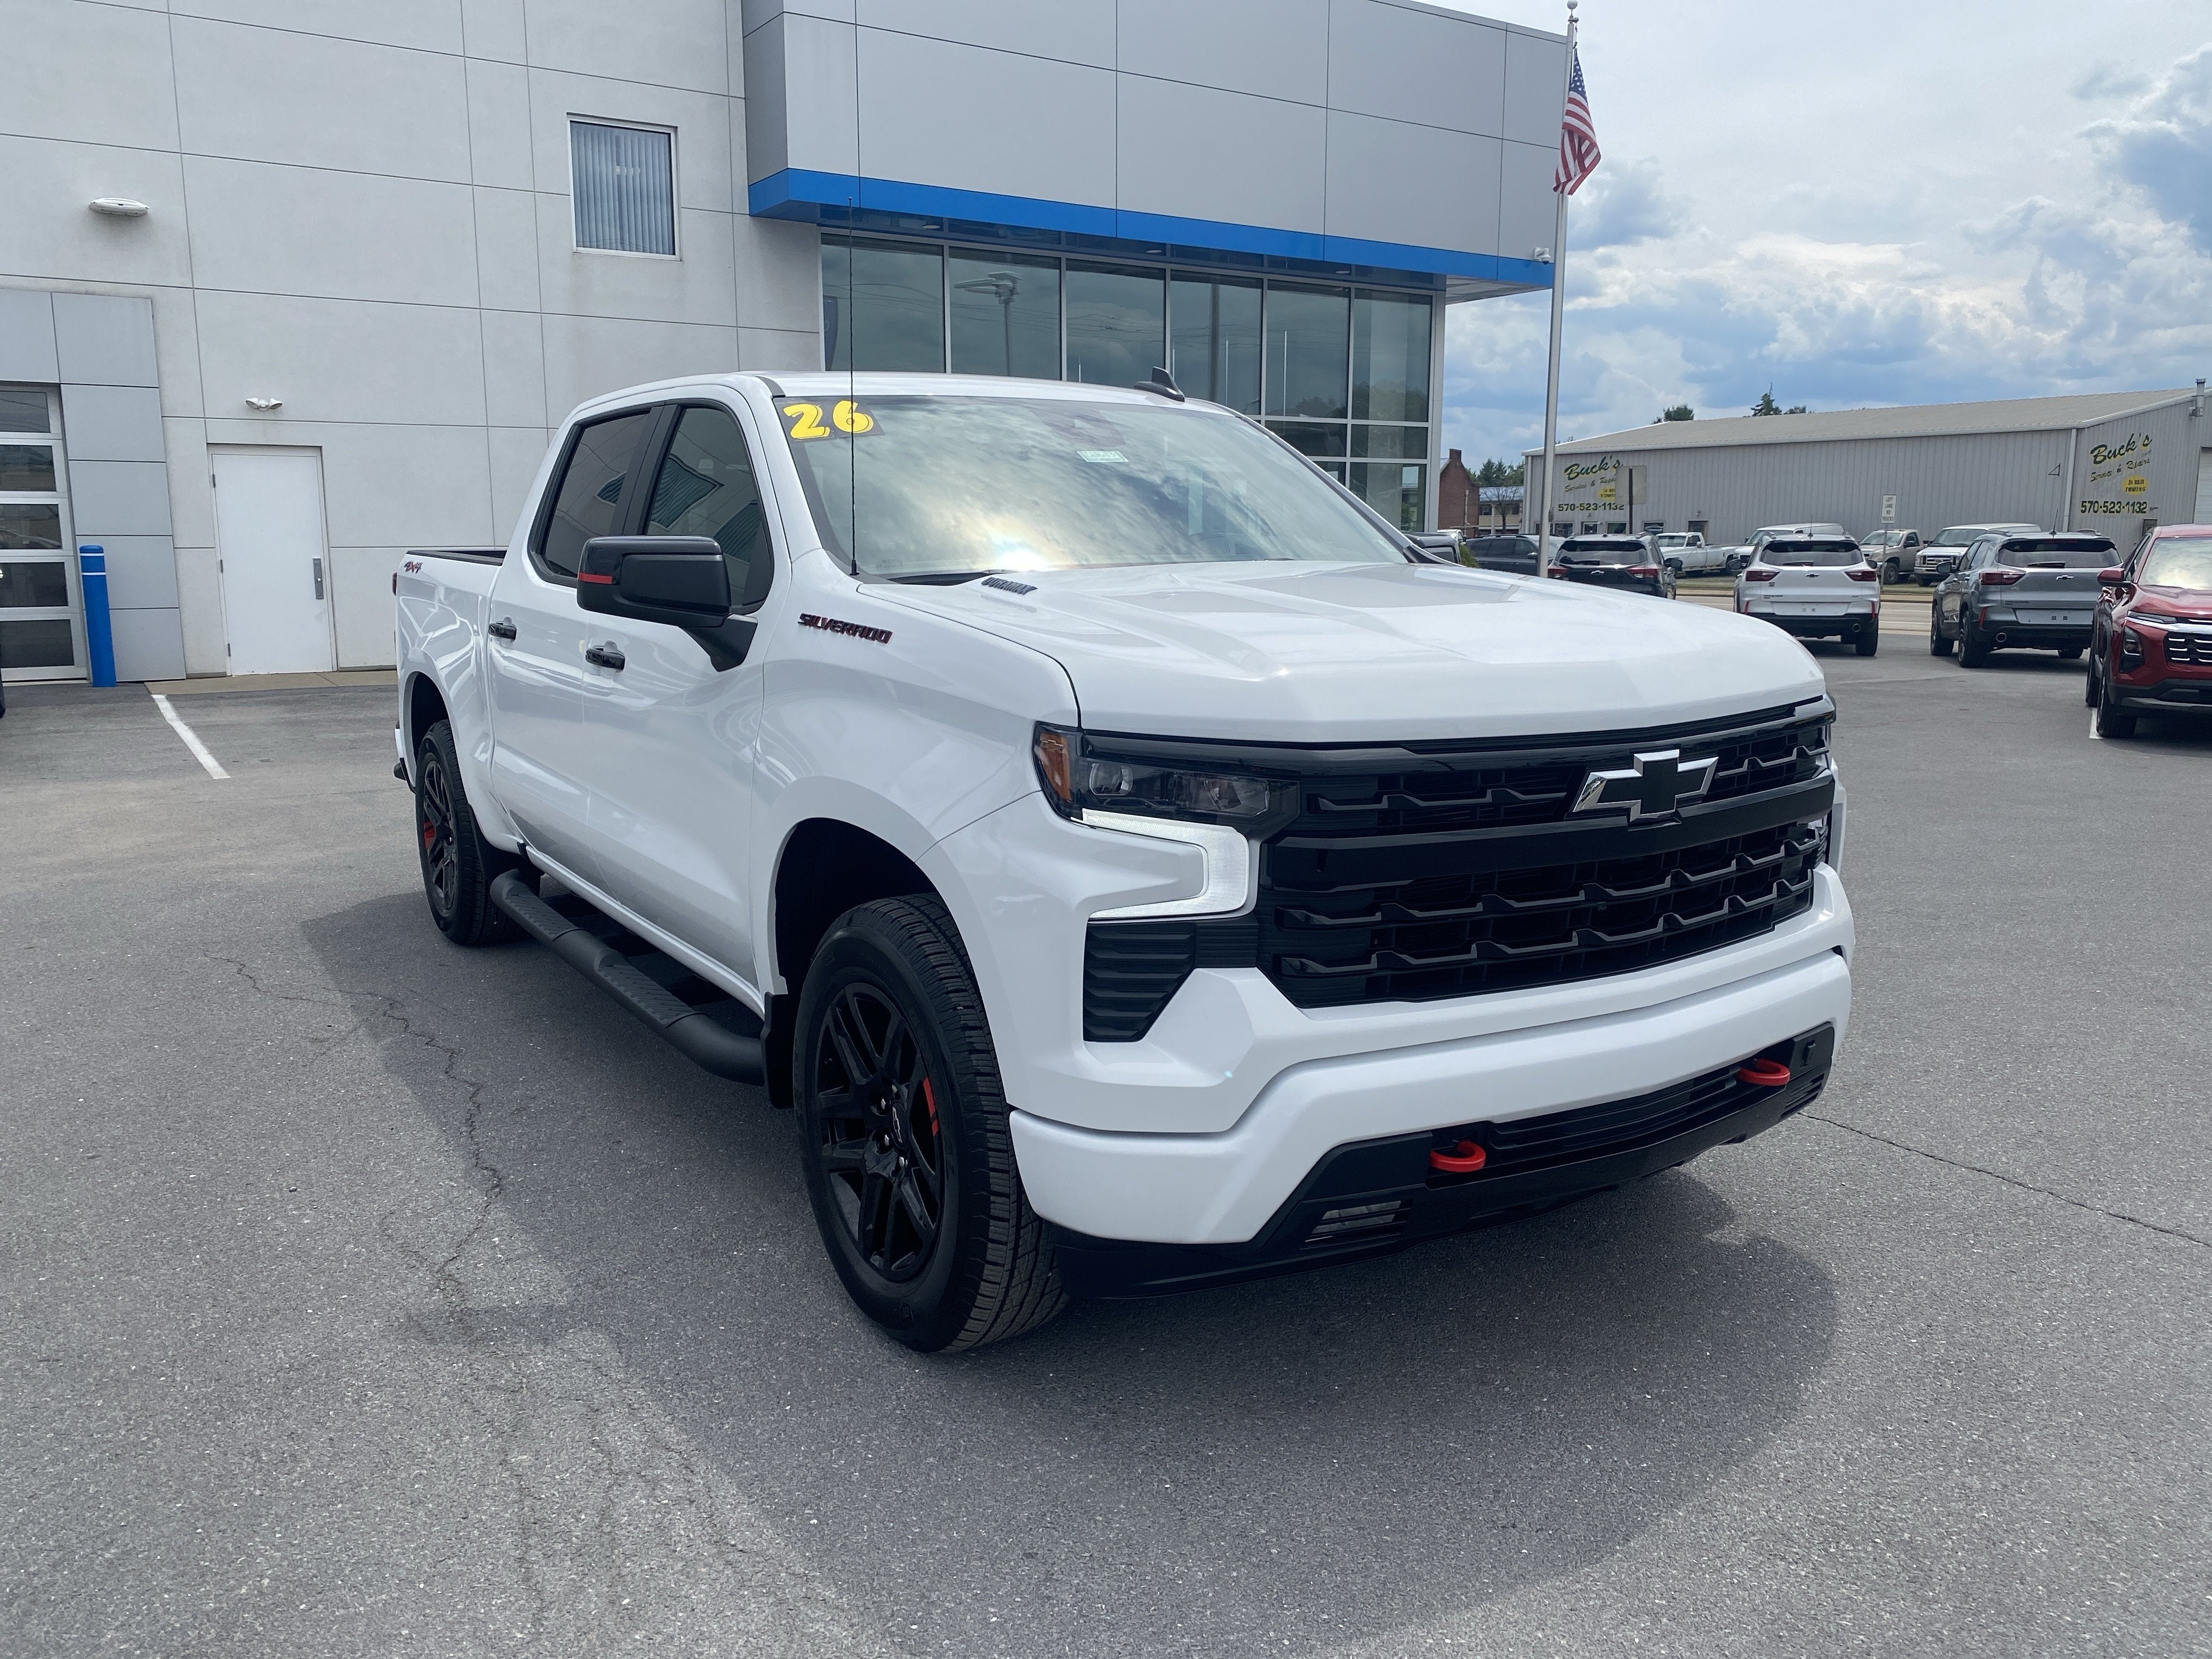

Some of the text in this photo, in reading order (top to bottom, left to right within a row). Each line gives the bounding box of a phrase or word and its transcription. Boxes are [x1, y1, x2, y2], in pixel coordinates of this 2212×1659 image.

[783, 399, 874, 439] 26
[2090, 432, 2153, 465] Buck's
[1564, 455, 1623, 481] Buck's
[981, 577, 1038, 595] DURAMAX
[798, 613, 893, 644] SILVERADO
